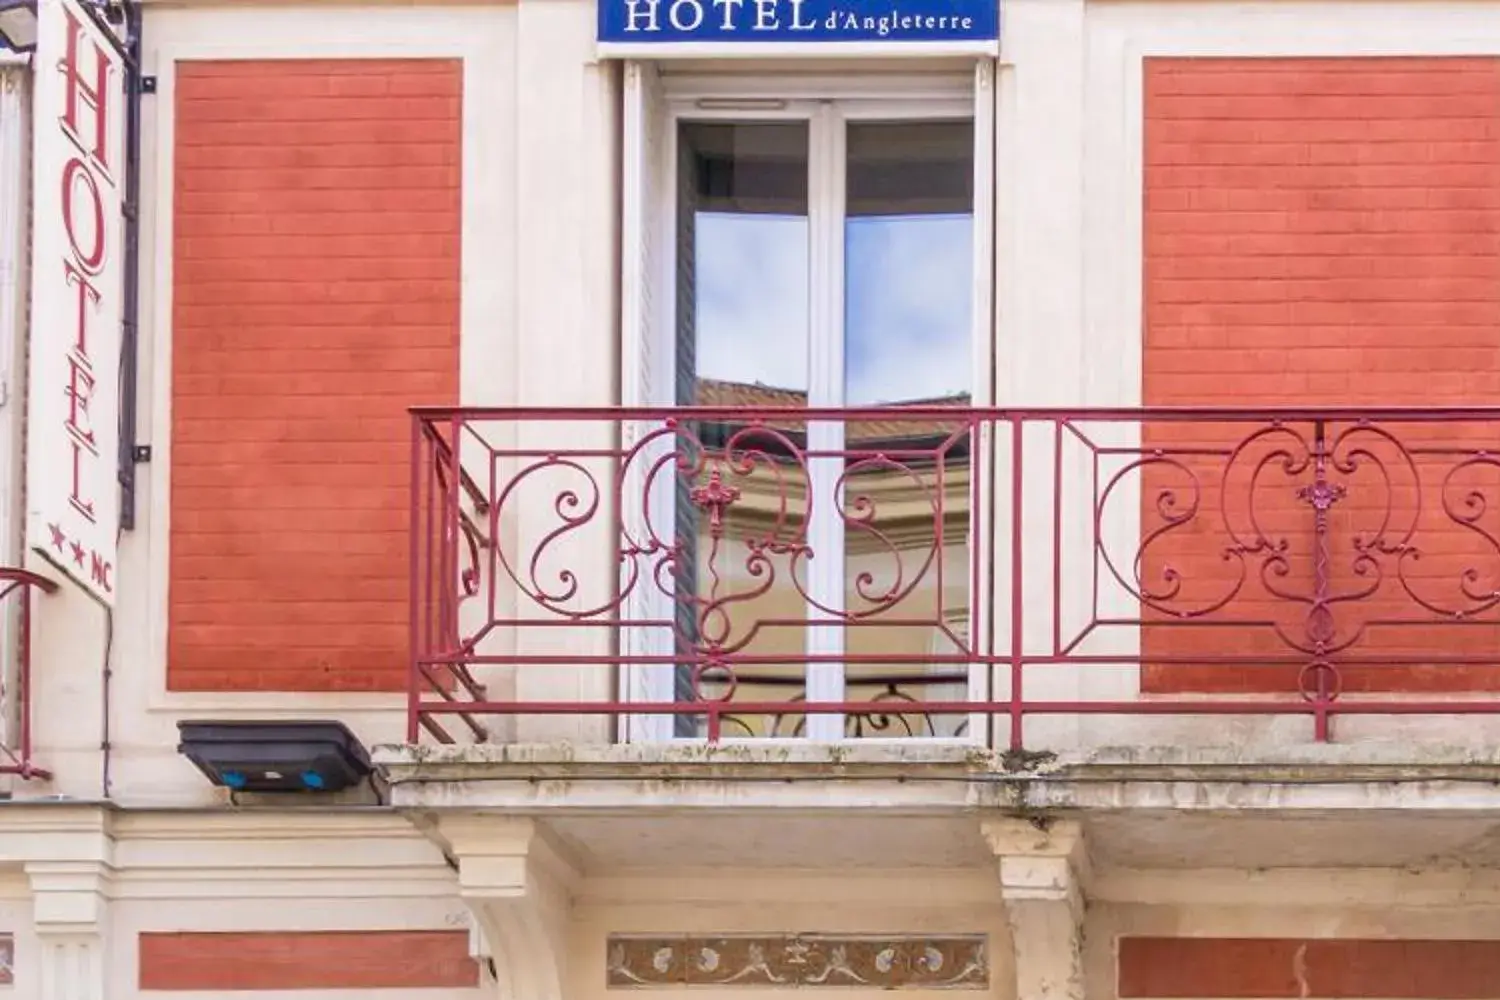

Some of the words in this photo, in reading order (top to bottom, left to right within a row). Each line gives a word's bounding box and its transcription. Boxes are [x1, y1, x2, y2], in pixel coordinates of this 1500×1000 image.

[623, 0, 817, 31] HOTEL
[825, 11, 973, 35] d'Angleterre
[57, 4, 115, 523] HOTEL
